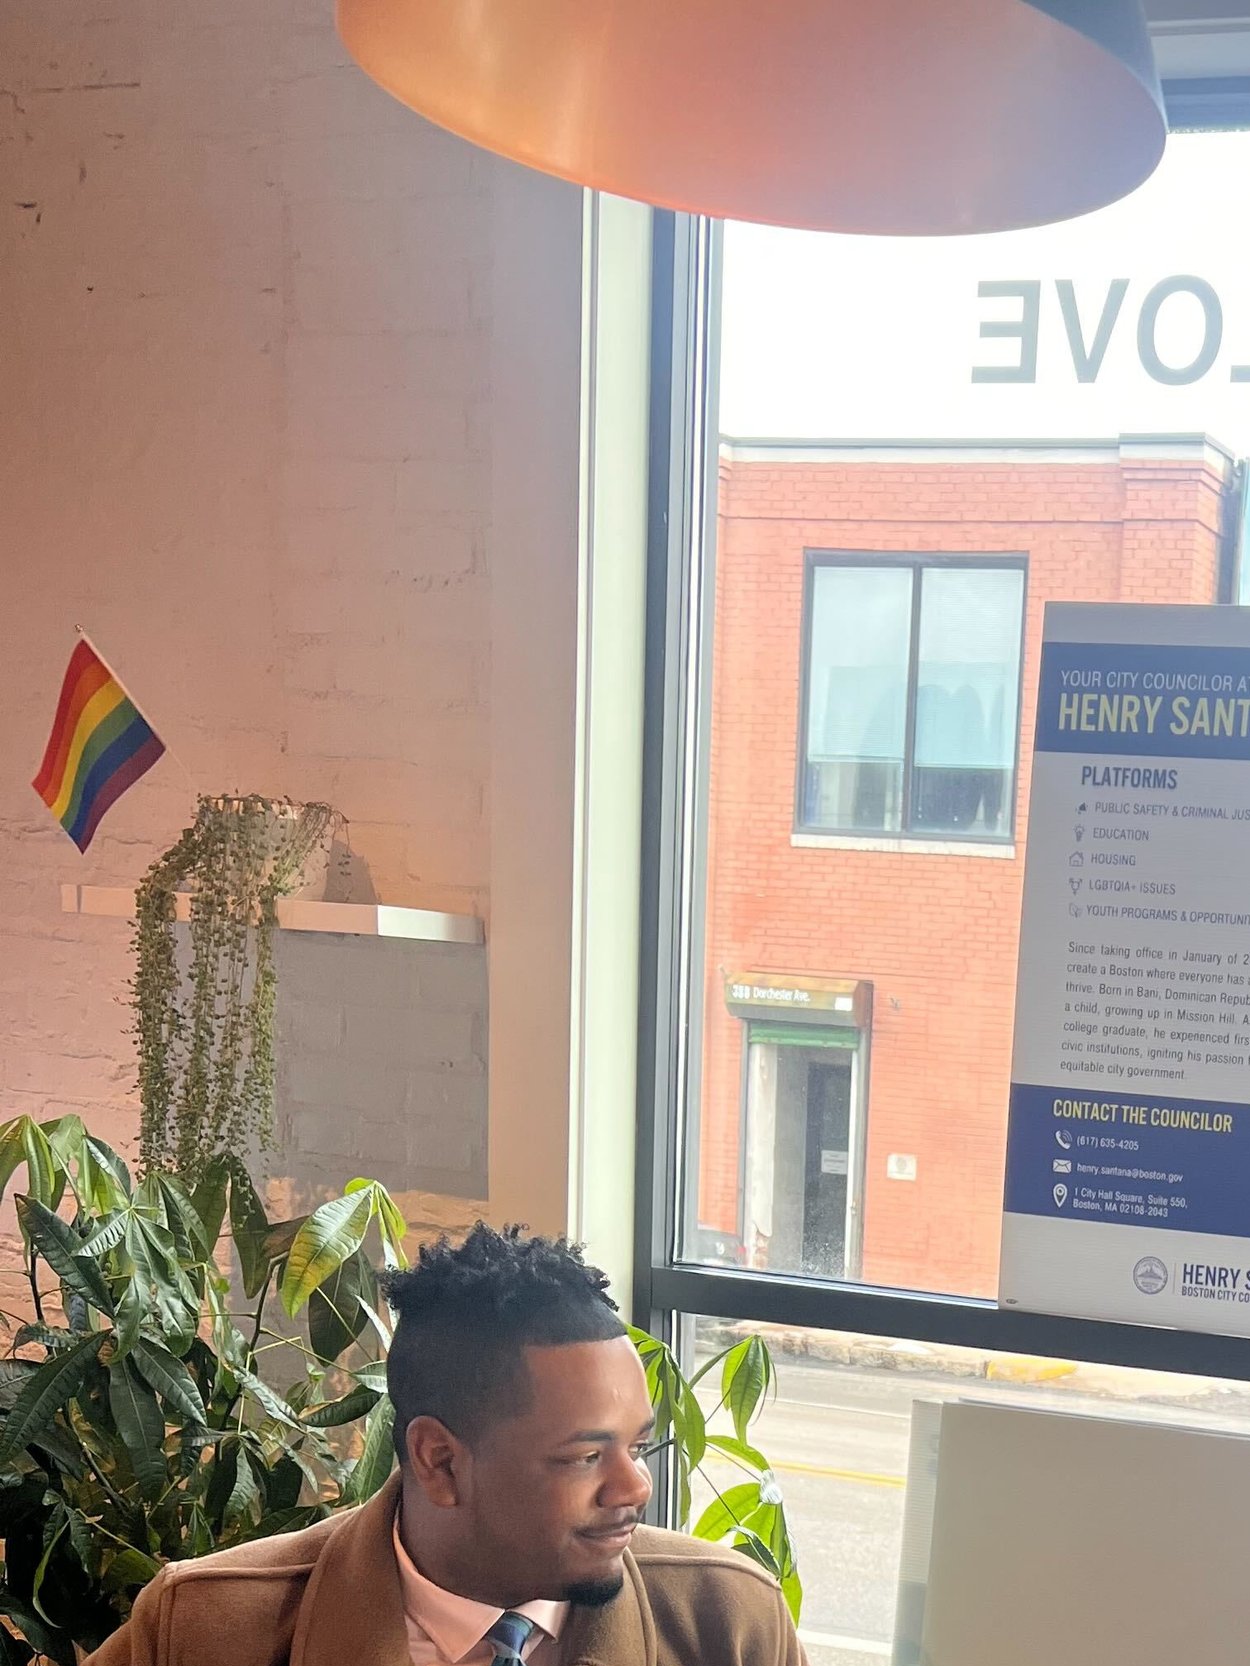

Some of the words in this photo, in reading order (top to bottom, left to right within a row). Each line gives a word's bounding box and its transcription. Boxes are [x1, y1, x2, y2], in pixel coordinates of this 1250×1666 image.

[1061, 670, 1101, 687] YOUR
[1107, 671, 1139, 688] CITY
[1143, 673, 1233, 692] COUNCILOR
[1058, 693, 1163, 733] HENRY
[1082, 766, 1178, 789] PLATFORMS
[1095, 802, 1129, 814] PUBLIC
[1133, 804, 1169, 816] SAFETY
[1172, 806, 1178, 816] &
[1181, 807, 1228, 819] CRIMINAL
[1093, 827, 1149, 840] EDUCATION
[1091, 853, 1136, 865] HOUSING
[1089, 880, 1135, 892] LGBTQIA+
[1140, 883, 1176, 895] ISSUES
[1087, 905, 1118, 917] YOUTH
[1122, 907, 1177, 921] PROGRAMS
[1180, 911, 1187, 922] &
[1069, 941, 1095, 954] Since
[1101, 944, 1130, 959] taking
[1136, 946, 1163, 959] office
[1169, 950, 1177, 960] in
[1183, 950, 1221, 965] January
[1228, 953, 1237, 964] of
[1067, 963, 1097, 974] create
[1109, 965, 1143, 977] Boston
[1146, 968, 1175, 980] where
[1179, 971, 1223, 984] everyone
[1227, 973, 1244, 985] has
[753, 986, 792, 1001] Dorchester
[1099, 983, 1121, 996] Born
[1125, 986, 1133, 996] in
[1165, 989, 1216, 1003] Dominican
[1075, 1002, 1100, 1015] child,
[1105, 1005, 1143, 1018] growing
[1148, 1009, 1159, 1020] up
[1164, 1009, 1172, 1019] in
[1177, 1009, 1214, 1022] Mission
[1064, 1021, 1098, 1035] college
[1102, 1025, 1148, 1039] graduate,
[1154, 1028, 1165, 1038] he
[1170, 1031, 1229, 1044] experienced
[1062, 1041, 1083, 1051] civic
[1087, 1043, 1142, 1058] institutions,
[1148, 1048, 1183, 1062] igniting
[1188, 1051, 1201, 1061] his
[1206, 1054, 1243, 1065] passion
[1060, 1060, 1104, 1072] equitable
[1107, 1064, 1124, 1076] city
[1053, 1099, 1118, 1122] CONTACT
[1122, 1105, 1148, 1125] THE
[1151, 1108, 1232, 1132] COUNCILOR
[1077, 1136, 1099, 1148] (617)
[1100, 1137, 1139, 1150] 635-4205
[1077, 1163, 1183, 1183] henry.santana@boston.gov
[1081, 1188, 1096, 1199] City
[1098, 1190, 1113, 1200] Hall
[1148, 1195, 1167, 1205] Suite
[1105, 1202, 1117, 1212] MA
[1183, 1263, 1240, 1289] HENRY
[1182, 1286, 1215, 1299] BOSTON
[1217, 1290, 1237, 1301] CITY
